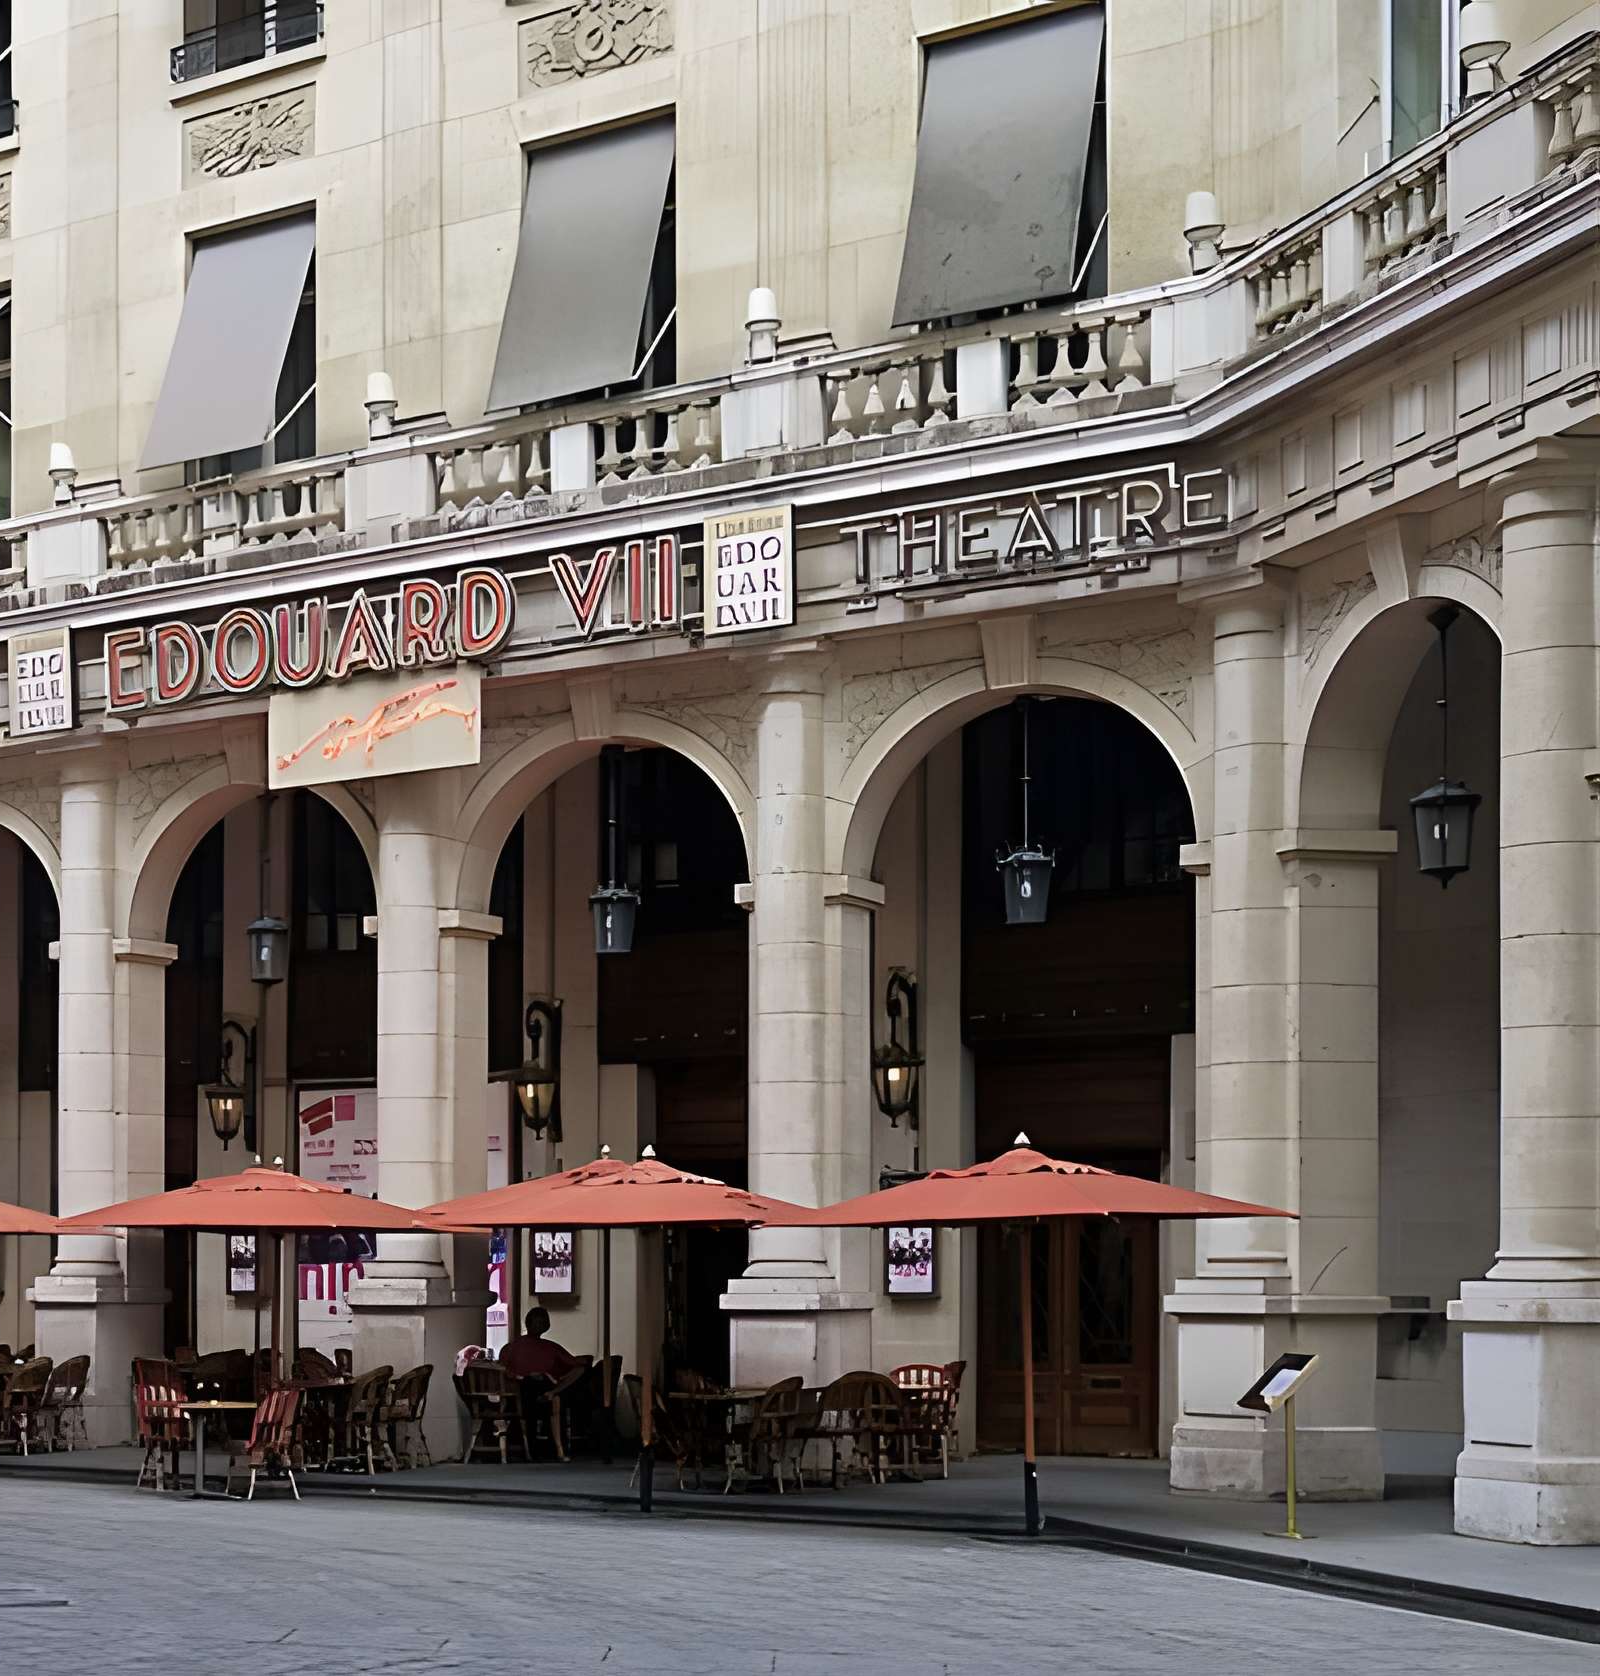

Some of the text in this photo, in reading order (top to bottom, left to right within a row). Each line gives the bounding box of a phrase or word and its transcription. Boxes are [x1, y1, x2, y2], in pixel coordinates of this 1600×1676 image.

[840, 468, 1225, 583] THEATRE
[105, 534, 678, 712] EDOUARD VII
